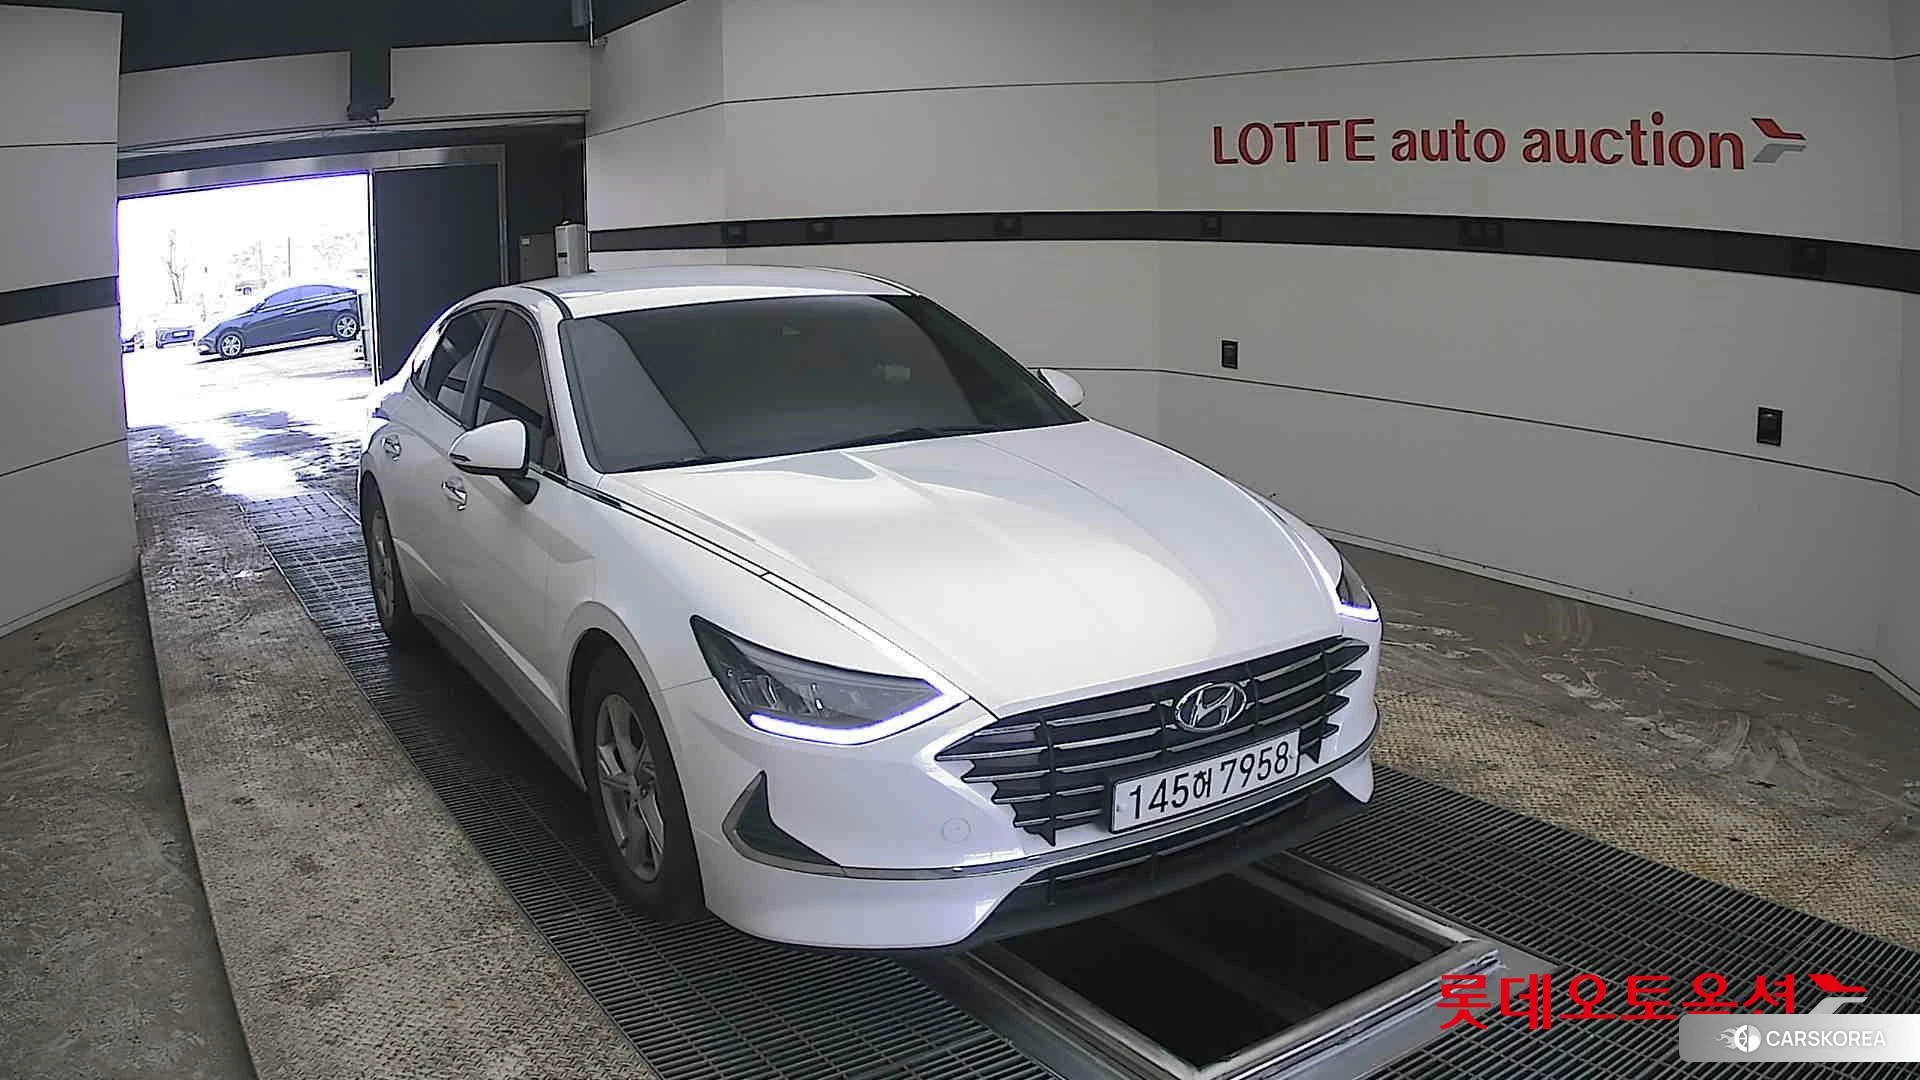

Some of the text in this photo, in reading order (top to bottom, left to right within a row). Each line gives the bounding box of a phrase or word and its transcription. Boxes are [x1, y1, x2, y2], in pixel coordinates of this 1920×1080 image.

[1212, 111, 1745, 170] LOTTE auto auction
